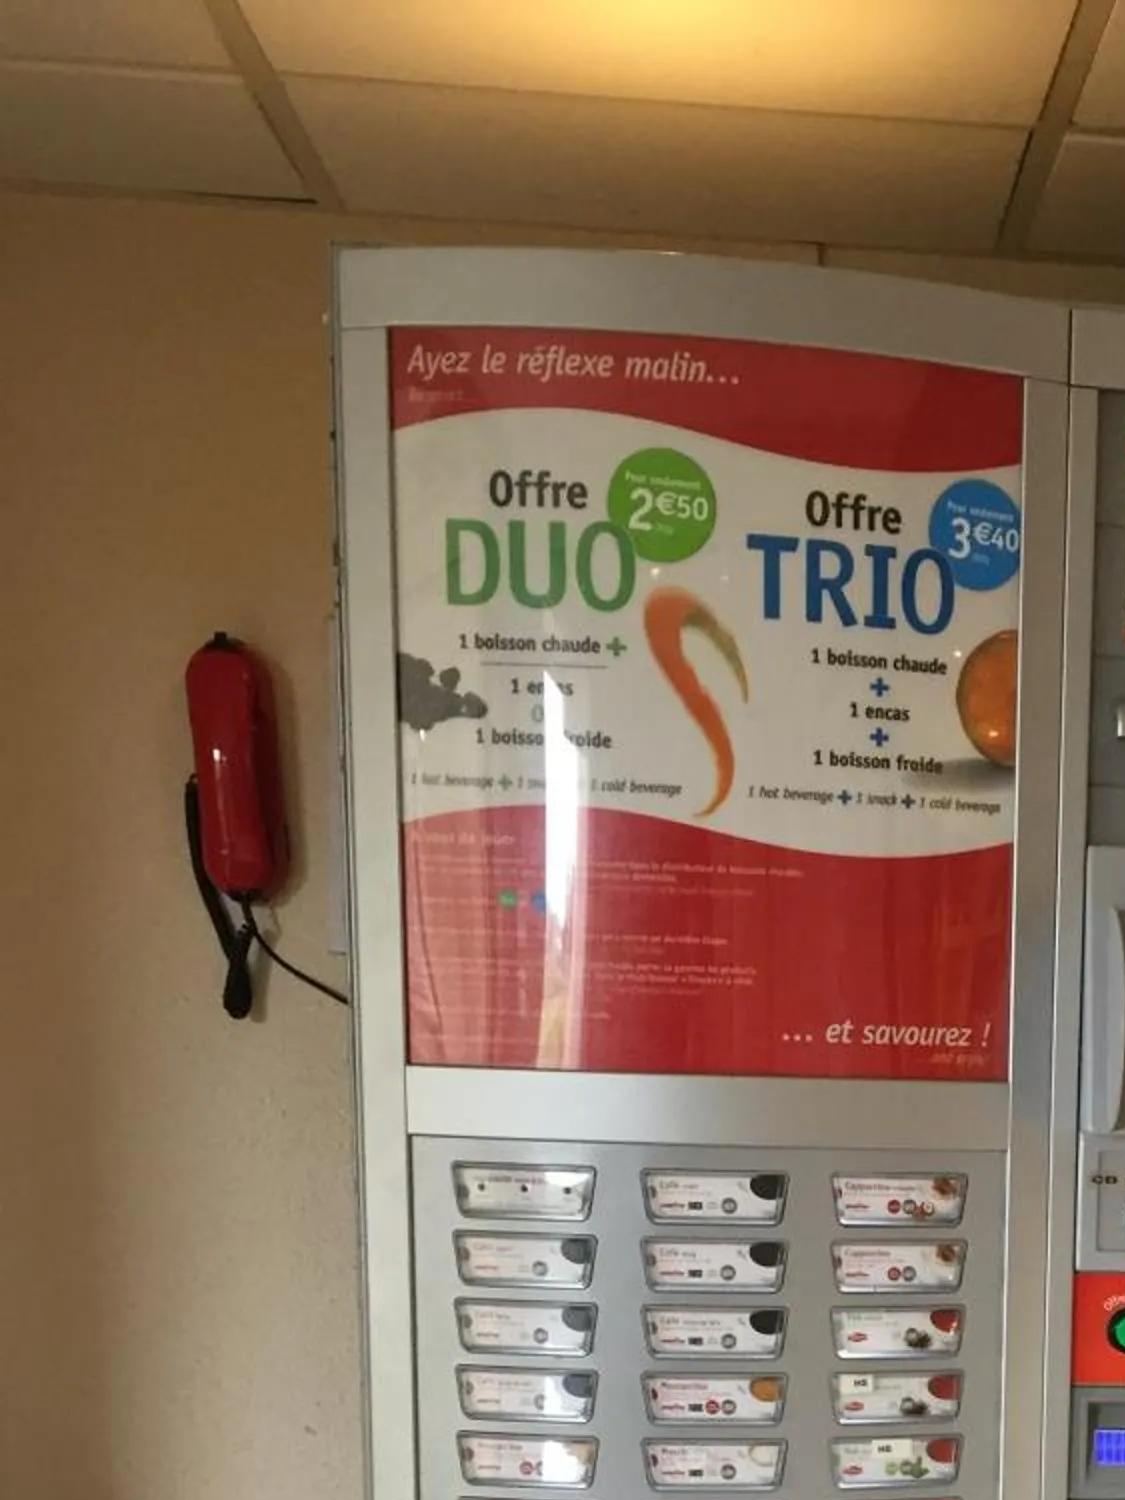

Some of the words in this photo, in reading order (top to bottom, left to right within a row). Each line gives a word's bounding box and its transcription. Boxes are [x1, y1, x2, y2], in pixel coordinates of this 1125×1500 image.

[407, 346, 470, 380] Ayez
[482, 344, 506, 374] le
[517, 346, 614, 382] réflexe
[489, 469, 588, 510] Offre
[628, 487, 709, 531] 2€50
[806, 489, 903, 535] Offre
[446, 517, 636, 612] DUO
[746, 532, 955, 636] TRIO
[459, 633, 468, 650] 1
[474, 633, 536, 652] boisson
[542, 634, 601, 654] chaude
[811, 649, 821, 664] 1
[827, 648, 887, 670] boisson
[893, 650, 948, 676] chaude
[511, 679, 519, 695] 1
[850, 702, 859, 718] 1
[865, 704, 910, 722] encas
[476, 728, 484, 744] 1
[491, 728, 545, 747] boisso
[814, 749, 823, 765] 1
[829, 751, 891, 771] boisson
[896, 756, 944, 775] froide
[825, 1018, 854, 1045] et
[862, 1023, 972, 1048] savourez
